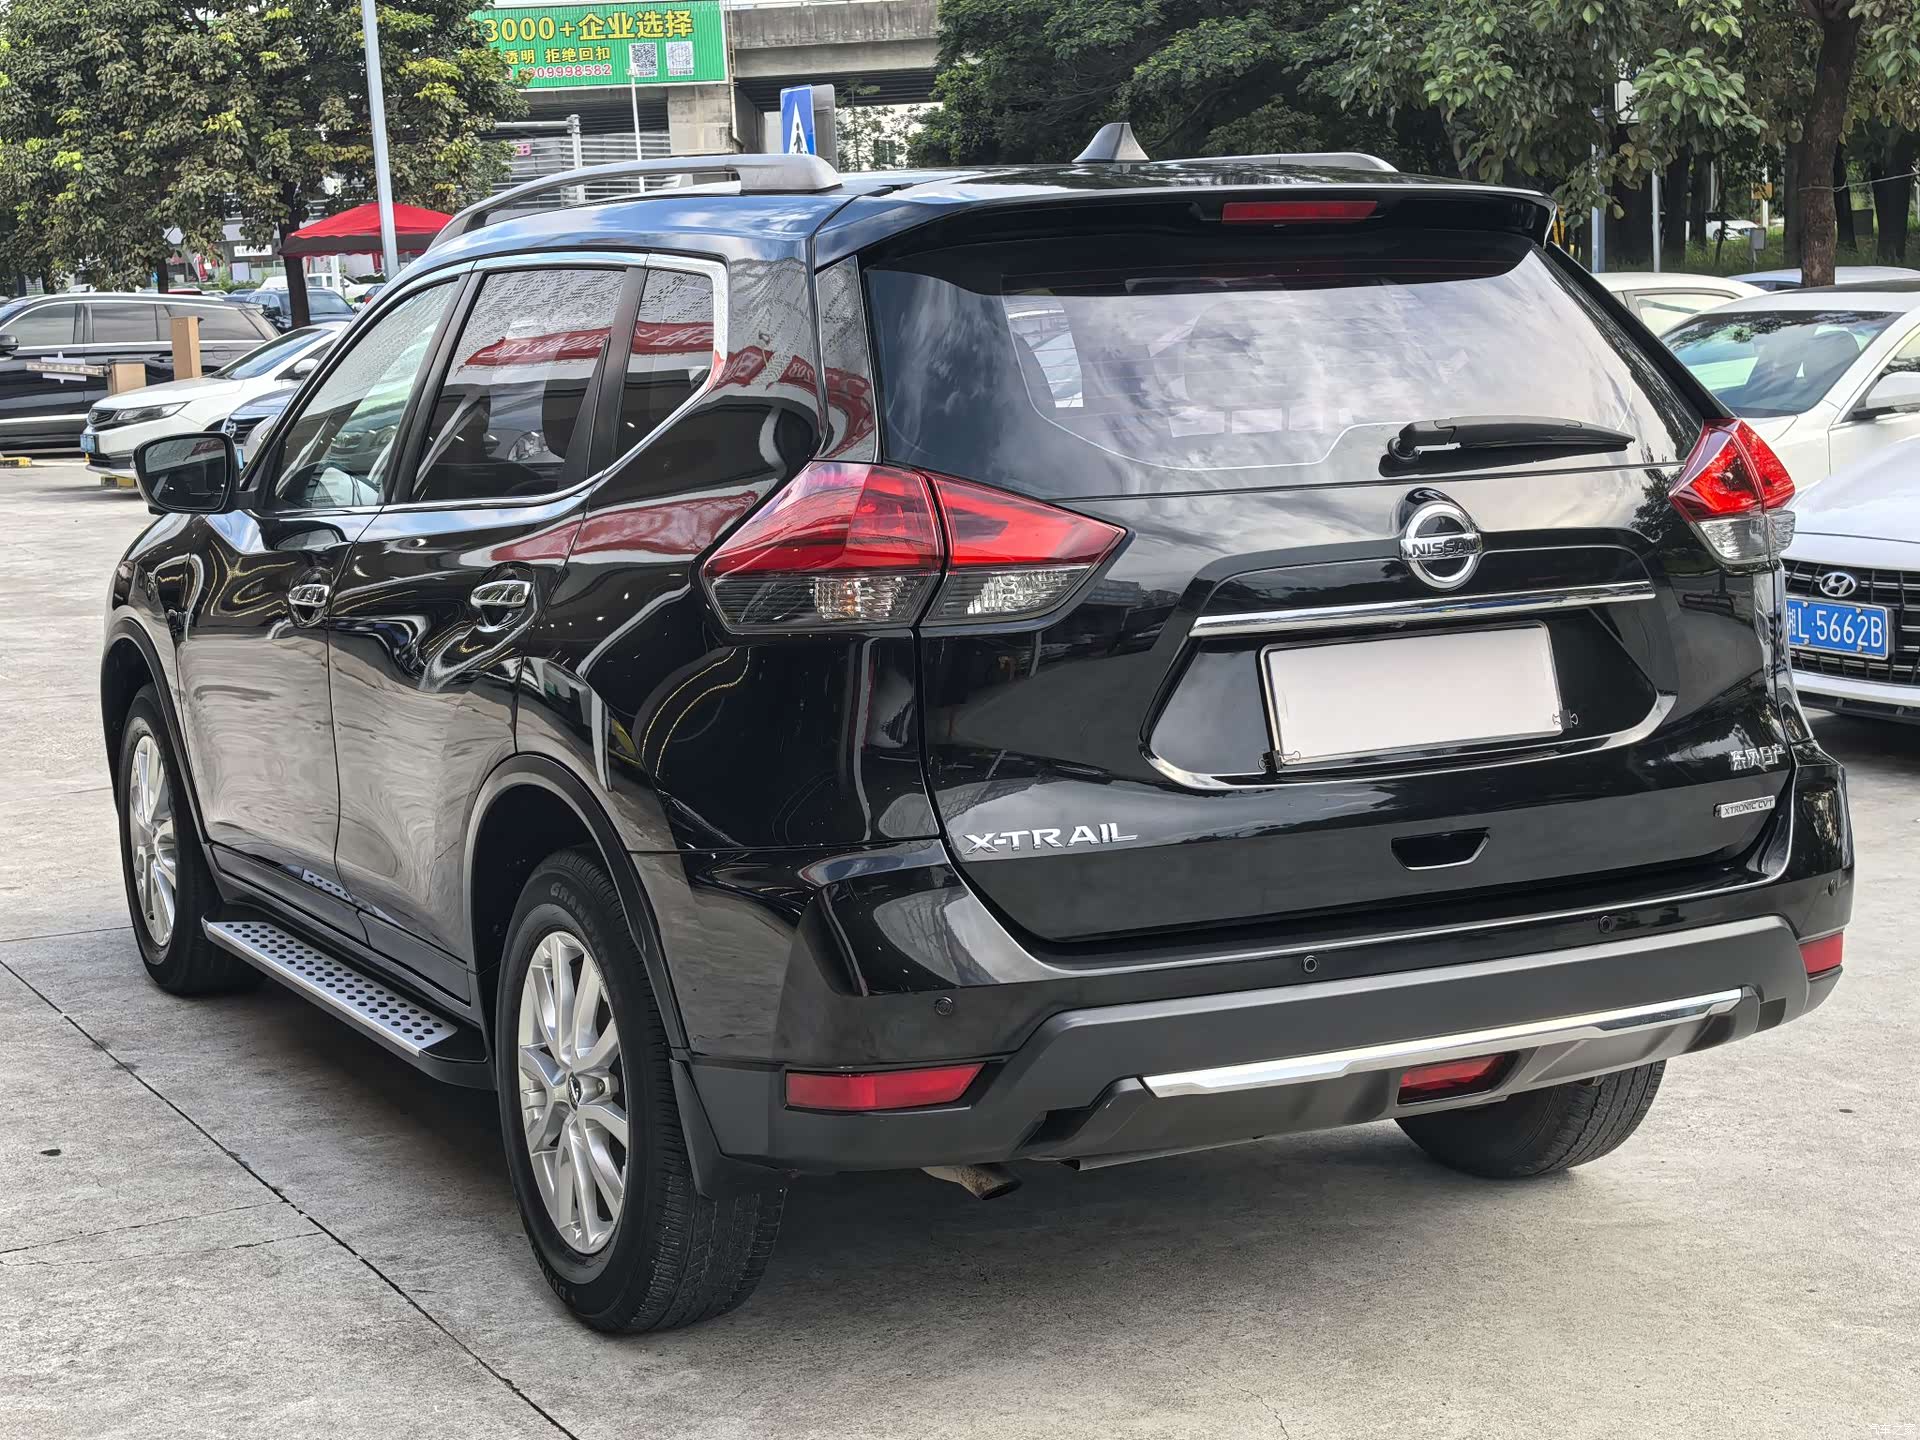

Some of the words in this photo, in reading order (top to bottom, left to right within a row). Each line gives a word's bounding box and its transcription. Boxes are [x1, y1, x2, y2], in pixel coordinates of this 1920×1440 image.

[483, 9, 693, 42] 3000+企业选择
[545, 46, 610, 63] 拒绝回扣
[1412, 540, 1476, 556] NISSAN
[1730, 743, 1786, 771] 东风日产
[1724, 801, 1757, 816] XTRONIC
[1758, 799, 1774, 809] CVT
[963, 822, 1138, 855] X-TRAIL
